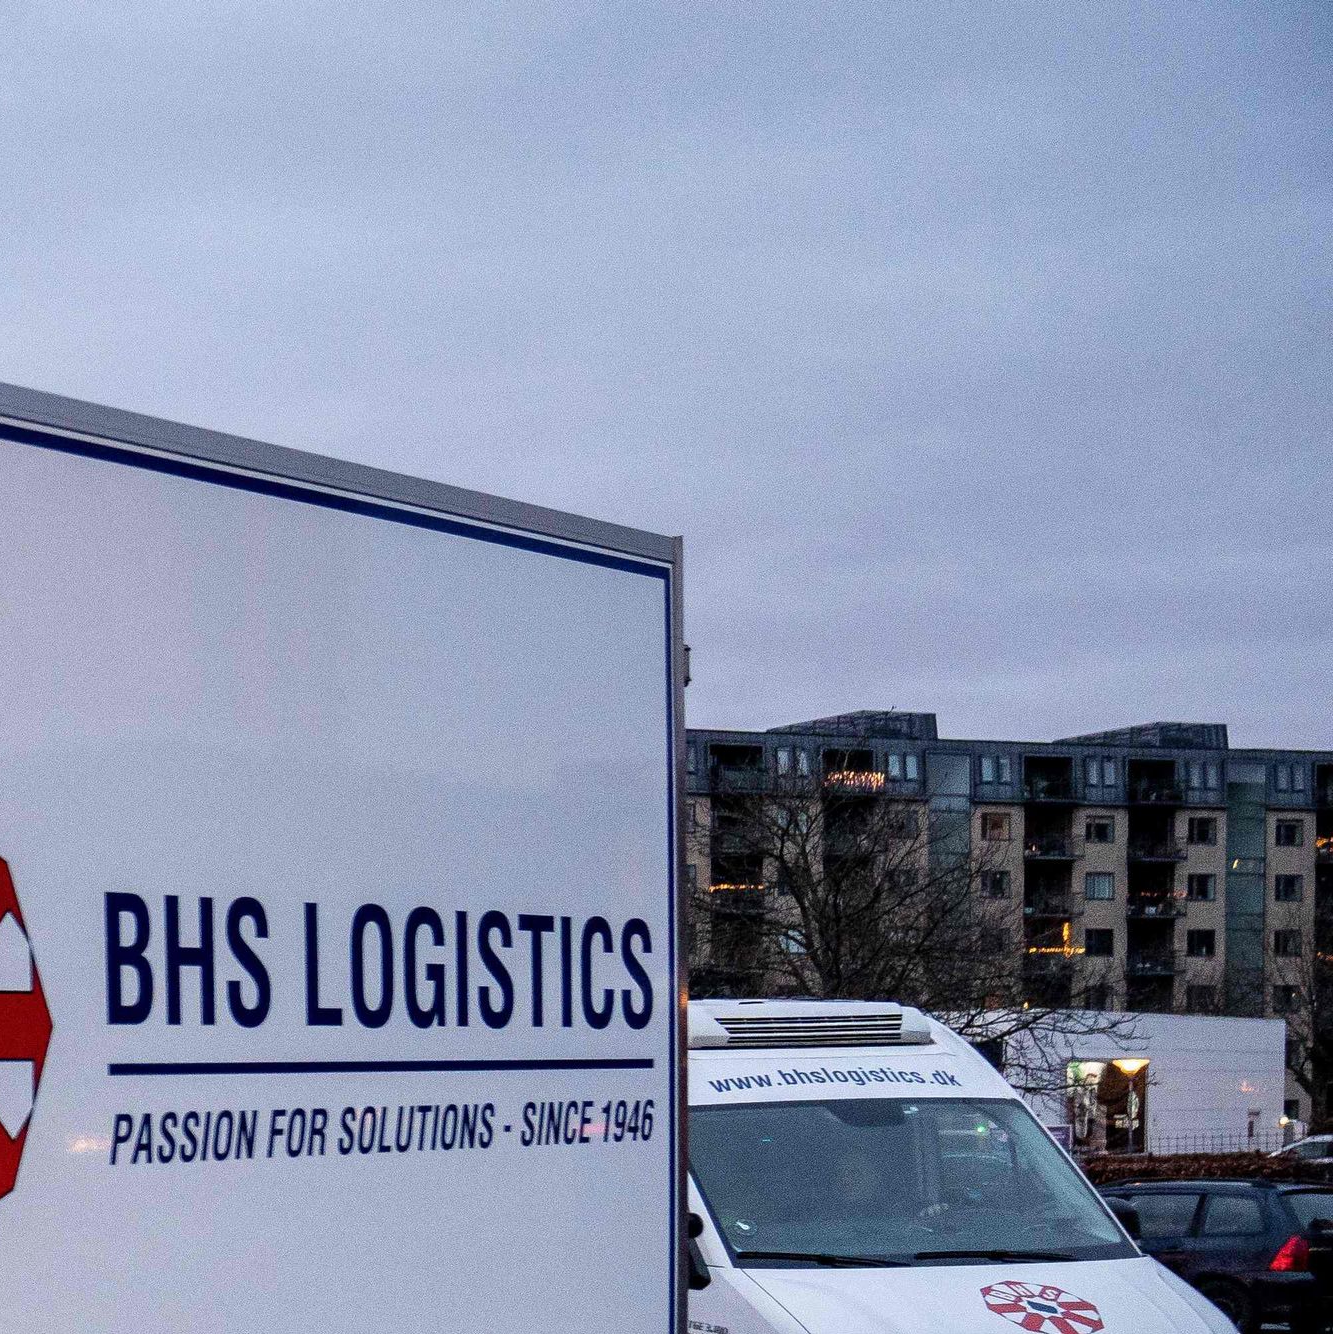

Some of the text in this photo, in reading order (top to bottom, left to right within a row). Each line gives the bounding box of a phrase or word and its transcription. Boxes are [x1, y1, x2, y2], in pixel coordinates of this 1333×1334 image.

[104, 890, 654, 1031] BHS LOGISTICS
[708, 1067, 963, 1093] www.bhslogistics.dk
[109, 1110, 258, 1165] PASSION
[266, 1107, 328, 1158] FOR
[337, 1102, 495, 1156] SOLUTIONS
[520, 1099, 595, 1148] SINCE
[601, 1098, 655, 1143] 1946
